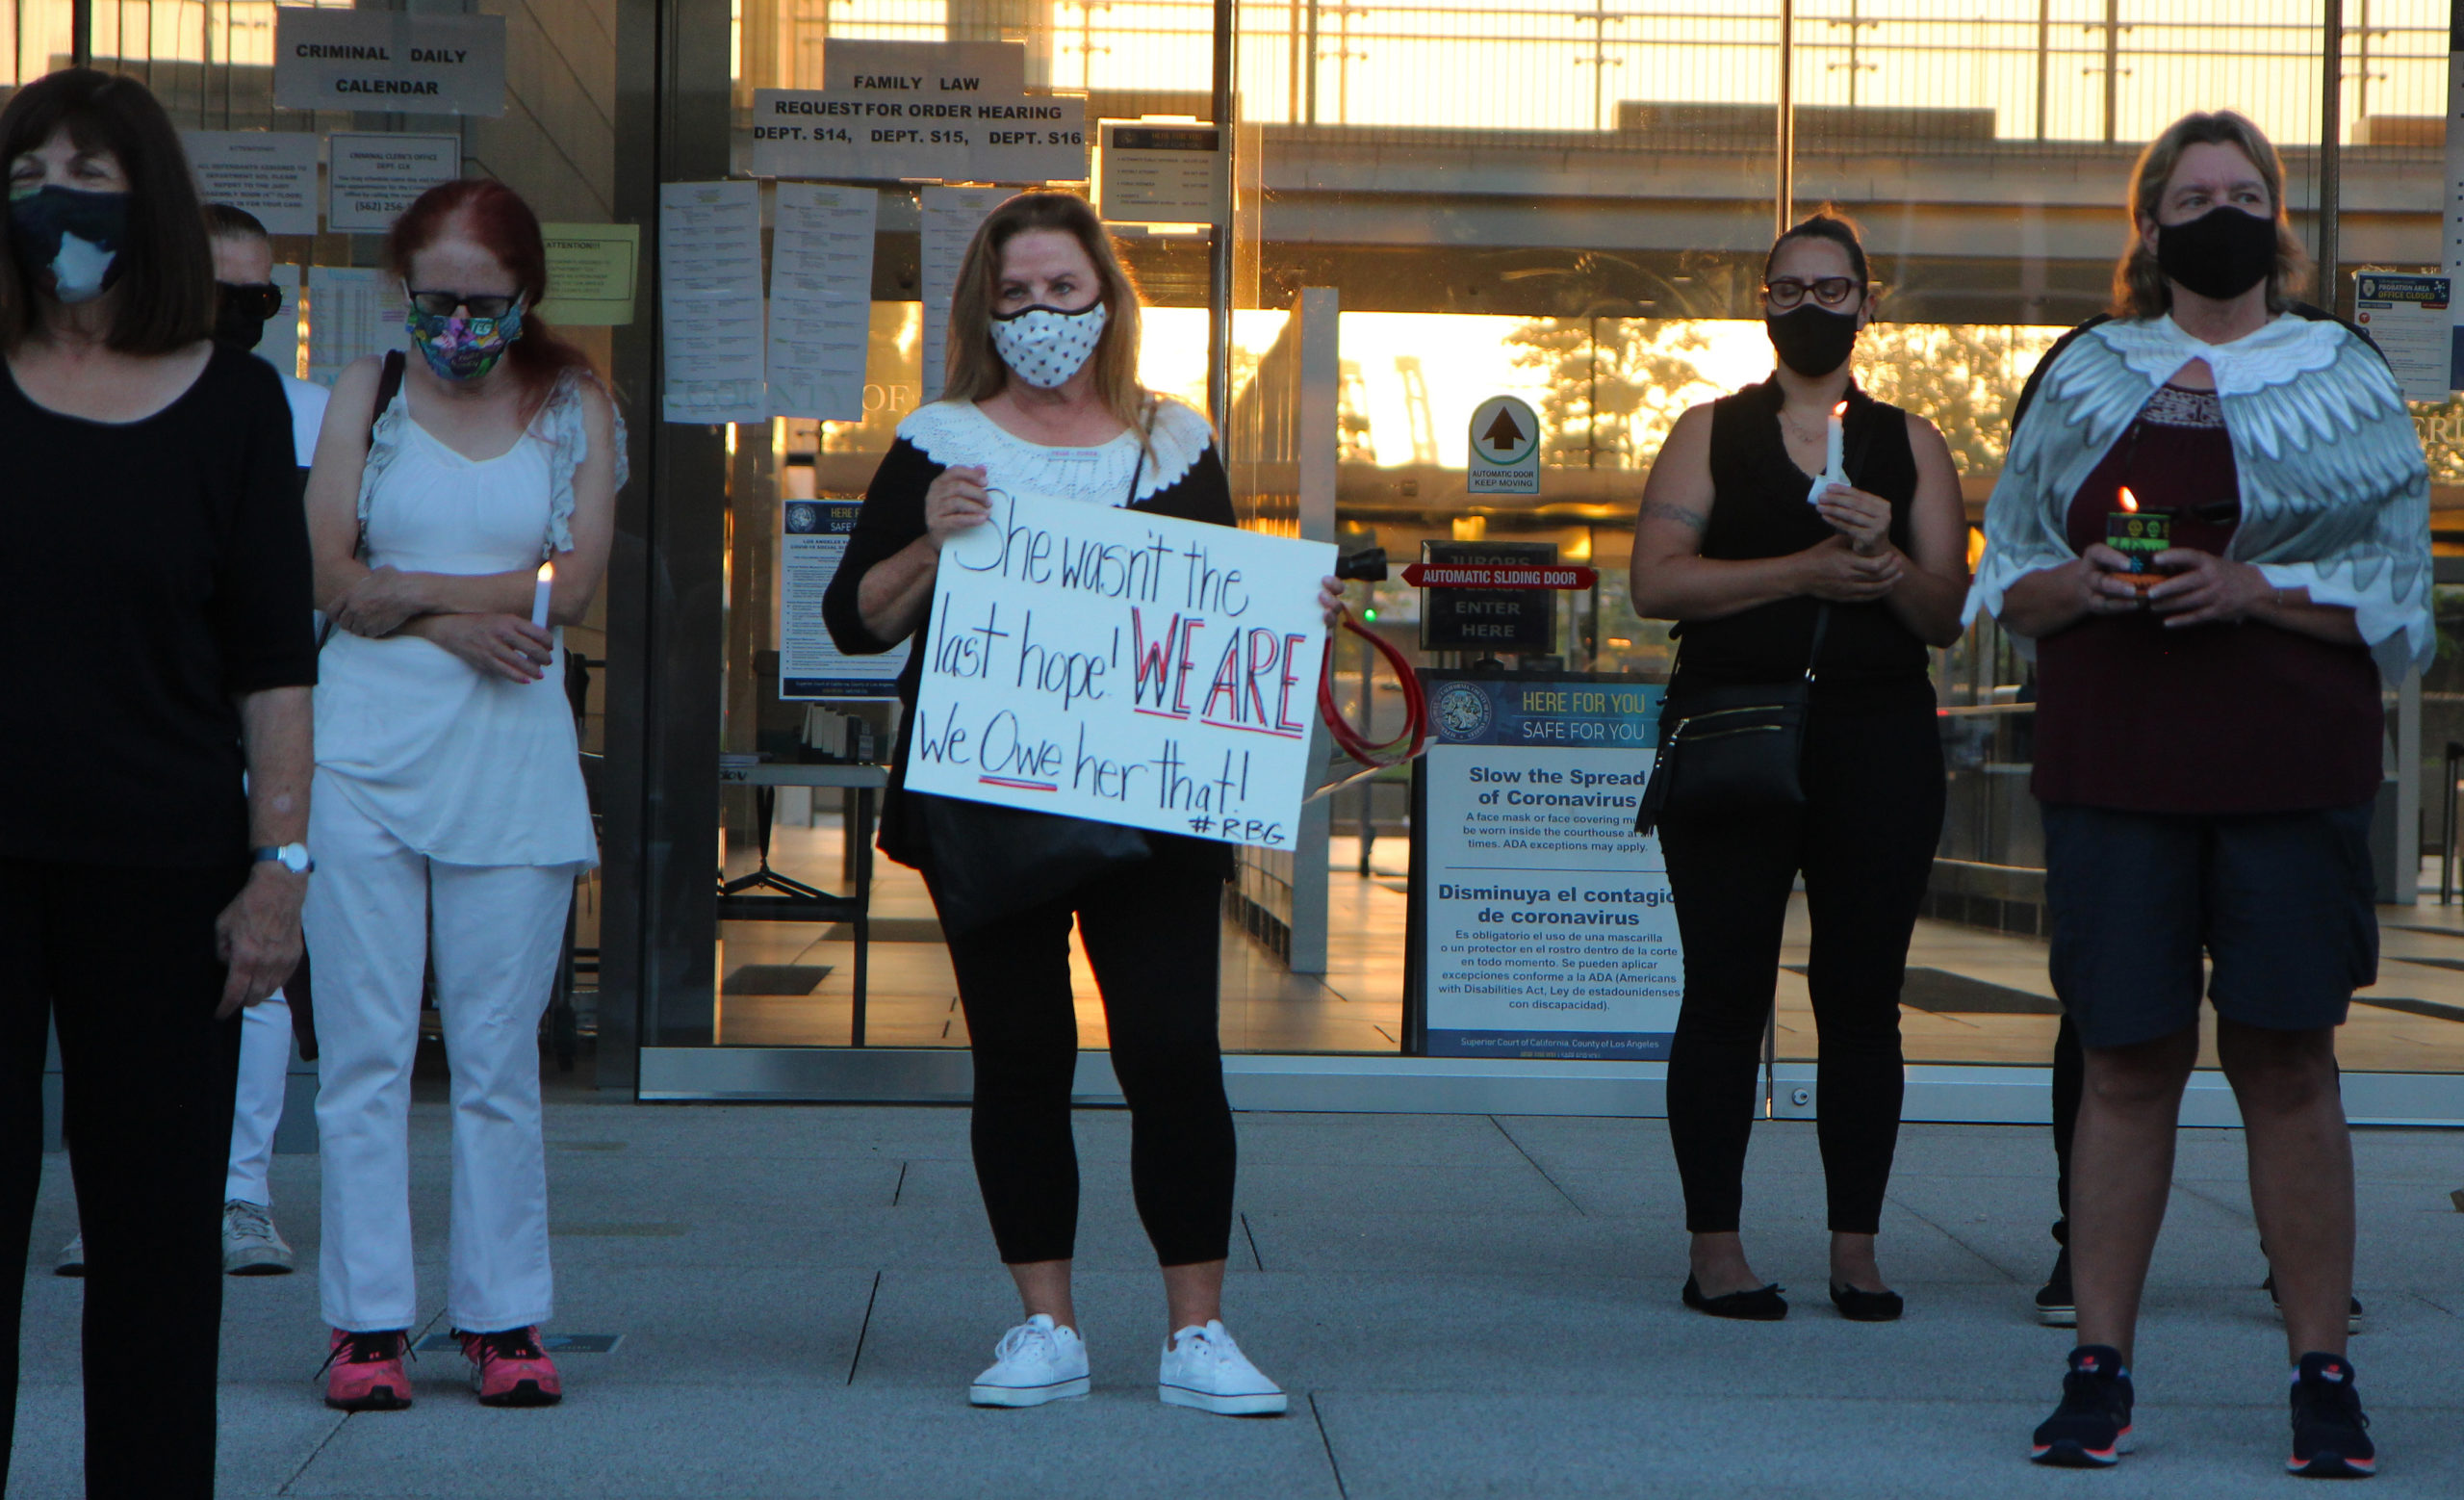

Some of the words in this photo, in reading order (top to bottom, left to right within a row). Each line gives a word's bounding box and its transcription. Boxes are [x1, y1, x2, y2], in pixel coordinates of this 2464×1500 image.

[296, 44, 389, 60] CRIMINAL
[411, 49, 467, 63] DAILY
[336, 79, 438, 94] CALENDAR
[854, 76, 922, 90] FAMILY
[939, 78, 980, 91] LAW
[775, 101, 862, 116] REQUEST
[866, 103, 902, 116] FOR
[909, 104, 972, 117] ORDER
[978, 106, 1062, 119] HEARING
[754, 126, 807, 140] DEPT.
[813, 127, 852, 143] S14,
[871, 130, 923, 142] DEPT.
[931, 131, 968, 145] S15,
[989, 132, 1041, 144] DEPT.
[1048, 132, 1081, 144] S16
[356, 201, 381, 213] (562)
[862, 384, 910, 412] OF
[832, 508, 852, 518] HERE
[954, 487, 1052, 583] She
[1062, 530, 1173, 603] wasn't
[1184, 541, 1249, 617] the
[1423, 570, 1490, 583] AUTOMATIC
[1495, 571, 1540, 583] SLIDING
[1544, 572, 1576, 584] DOOR
[1455, 602, 1521, 614] ENTER
[1462, 625, 1514, 636] HERE
[934, 592, 1009, 679] last
[1016, 609, 1119, 711] hope!
[1131, 606, 1205, 714] WE
[1201, 627, 1306, 732] ARE
[1523, 691, 1567, 711] HERE
[1573, 693, 1604, 712] FOR
[1611, 693, 1645, 713] YOU
[1523, 722, 1565, 738] SAFE
[1571, 723, 1604, 739] FOR
[1609, 724, 1644, 739] YOU
[919, 703, 970, 764] We
[980, 709, 1062, 776] Owe
[1073, 721, 1149, 801] her
[1149, 739, 1248, 814] that!
[1470, 767, 1522, 784] Slow
[1528, 769, 1563, 784] the
[1570, 769, 1645, 788] Spread
[1478, 790, 1500, 805] of
[1507, 790, 1636, 807] Coronavirus
[1466, 813, 1474, 821] A
[1476, 813, 1499, 821] face
[1502, 814, 1530, 822] mask
[1549, 814, 1570, 823] face
[1574, 815, 1620, 825] covering
[1189, 815, 1285, 845] #RBG
[1463, 826, 1476, 835] be
[1509, 827, 1540, 836] inside
[1564, 828, 1624, 837] courthouse
[1469, 840, 1500, 848] times.
[1530, 841, 1587, 851] exceptions
[1592, 842, 1613, 851] may
[1617, 842, 1648, 853] apply.
[1439, 885, 1550, 904] Disminuya
[1557, 887, 1576, 902] el
[1478, 908, 1503, 923] de
[1511, 911, 1639, 925] coronavirus
[1455, 930, 1469, 939] Es
[1473, 931, 1530, 942] obligatorio
[1533, 931, 1542, 940] el
[1569, 932, 1581, 941] de
[1608, 933, 1662, 943] mascarilla
[1468, 944, 1517, 954] protector
[1549, 945, 1580, 954] rostro
[1584, 946, 1619, 955] dentro
[1622, 946, 1634, 955] de
[1477, 958, 1502, 967] todo
[1505, 958, 1558, 967] momento.
[1562, 959, 1576, 968] Se
[1578, 960, 1619, 970] pueden
[1622, 961, 1657, 970] aplicar
[1442, 971, 1509, 981] excepciones
[1513, 972, 1564, 982] conforme
[1577, 972, 1585, 982] la
[1589, 973, 1612, 982] ADA
[1615, 973, 1677, 984] (Americans
[1439, 984, 1461, 994] with
[1464, 985, 1523, 995] Disabilities
[1526, 986, 1546, 996] Act,
[1551, 987, 1568, 997] Ley
[1573, 987, 1585, 996] de
[1589, 988, 1680, 996] estadounidenses
[1532, 999, 1609, 1011] discapacidad).
[1461, 1038, 1496, 1047] Superior
[1572, 1040, 1599, 1048] County
[1627, 1041, 1658, 1049] Angeles
